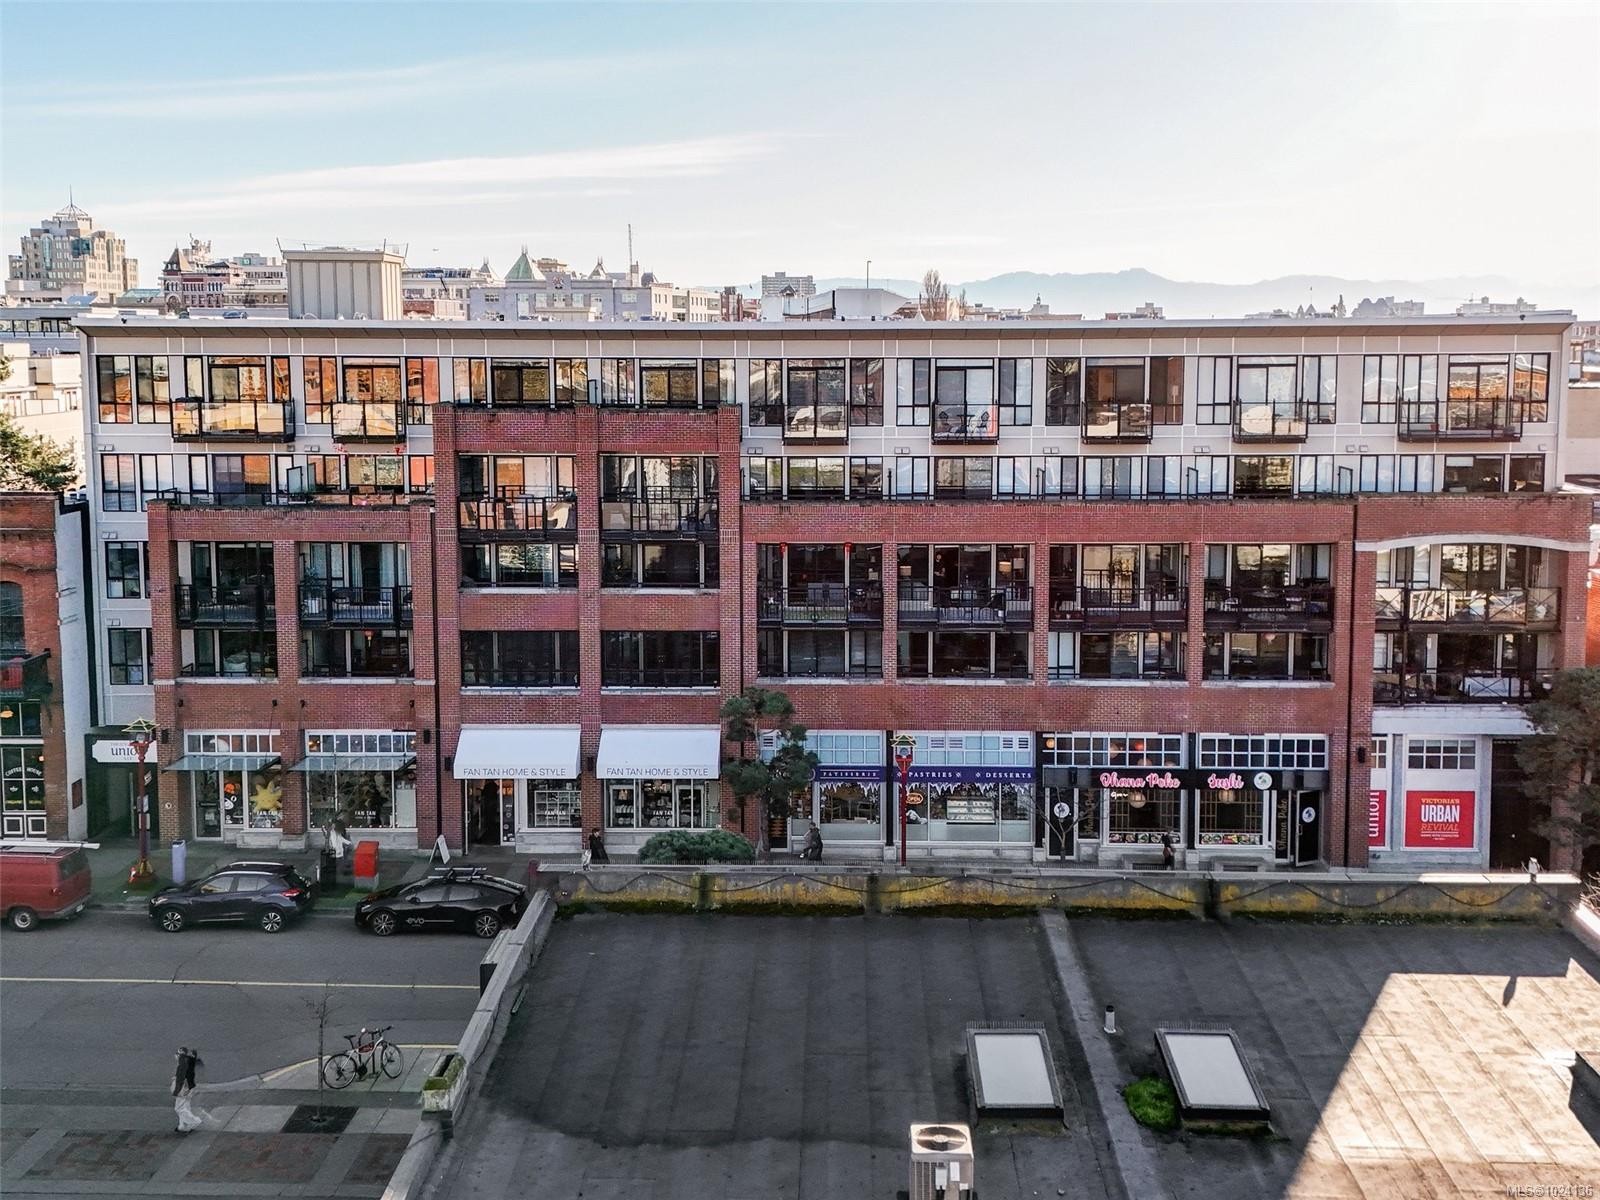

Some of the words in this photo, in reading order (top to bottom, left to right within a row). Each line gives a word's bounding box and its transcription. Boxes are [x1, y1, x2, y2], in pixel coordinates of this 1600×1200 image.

[463, 768, 481, 776] FAN
[483, 768, 500, 776] TAN
[502, 768, 529, 776] HOME
[531, 768, 538, 776] &
[539, 768, 566, 776] STYLE
[606, 768, 624, 776] FAN
[625, 768, 643, 776] TAN
[645, 768, 672, 776] HOME
[673, 768, 680, 776] &
[682, 768, 709, 776] STYLE
[1100, 771, 1146, 788] Ohana
[1146, 772, 1181, 788] Poke
[1207, 772, 1245, 790] Sushi
[1421, 805, 1460, 823] URBAN
[1421, 823, 1459, 831] REVIVAL
